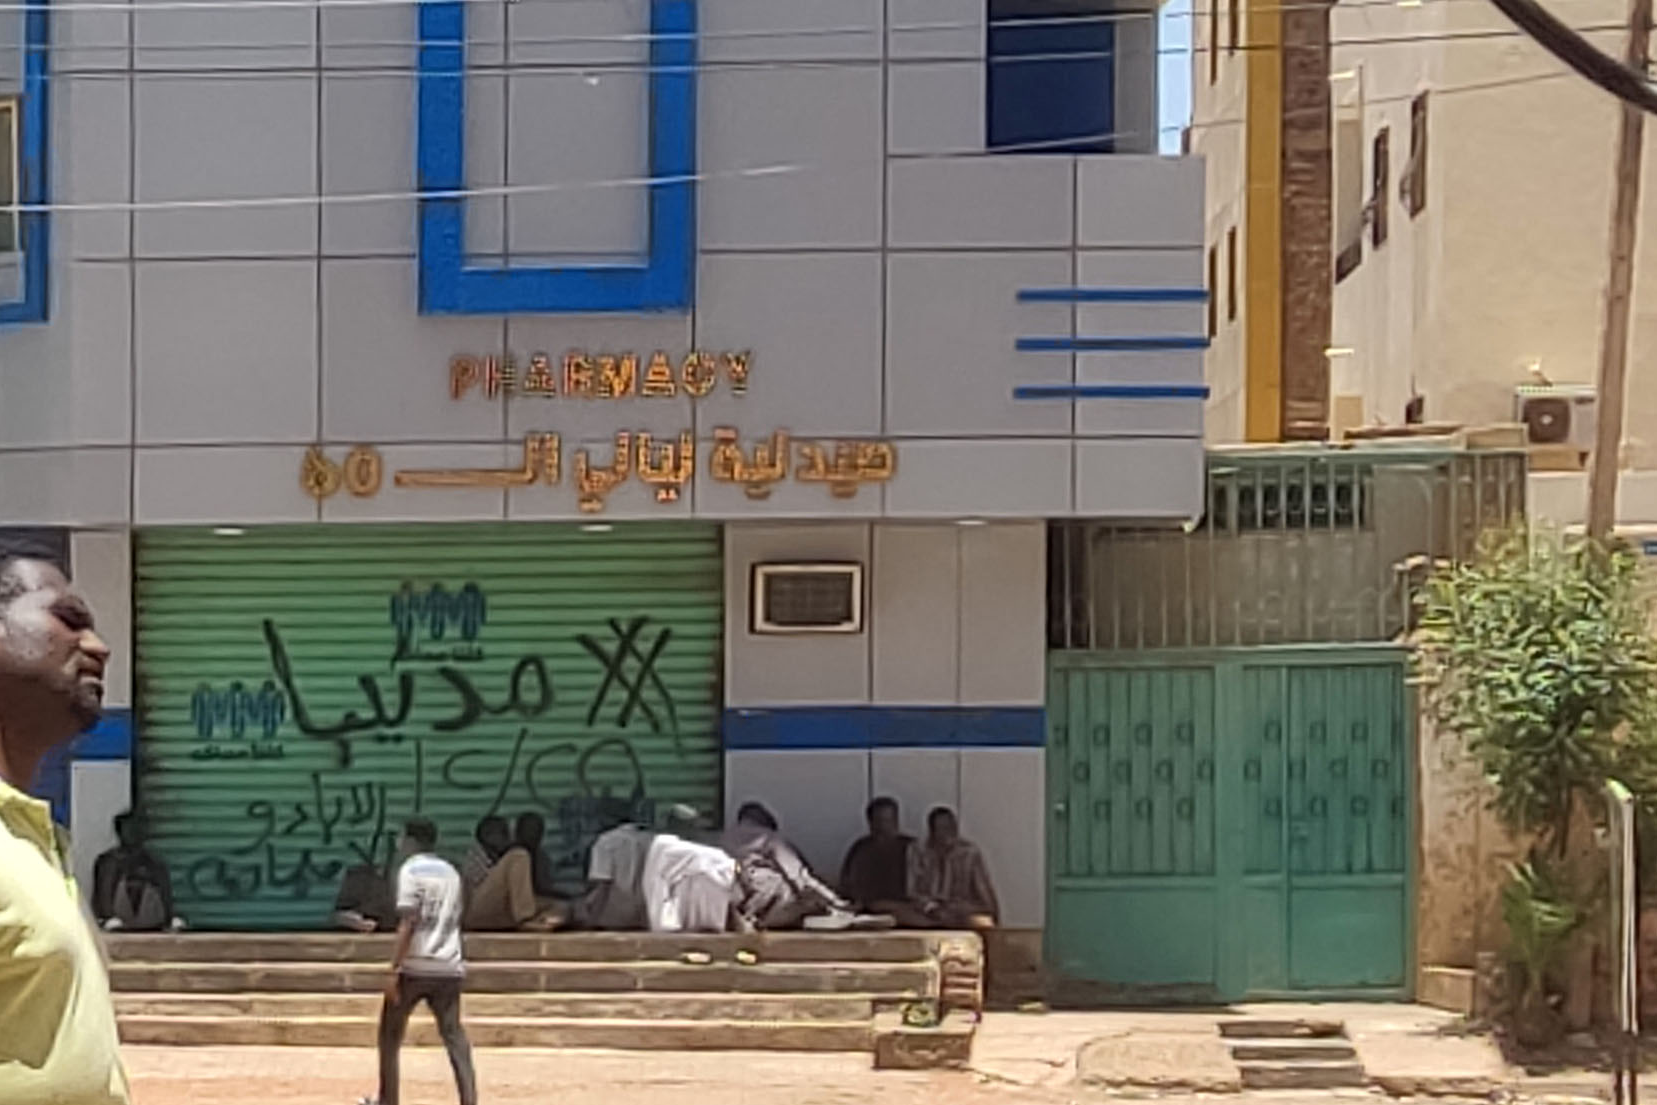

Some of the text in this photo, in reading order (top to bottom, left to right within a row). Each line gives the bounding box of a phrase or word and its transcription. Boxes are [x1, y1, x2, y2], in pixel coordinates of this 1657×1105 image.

[449, 350, 750, 399] PHARMACY
[572, 431, 694, 513] ليالي
[708, 427, 897, 500] صيدلية
